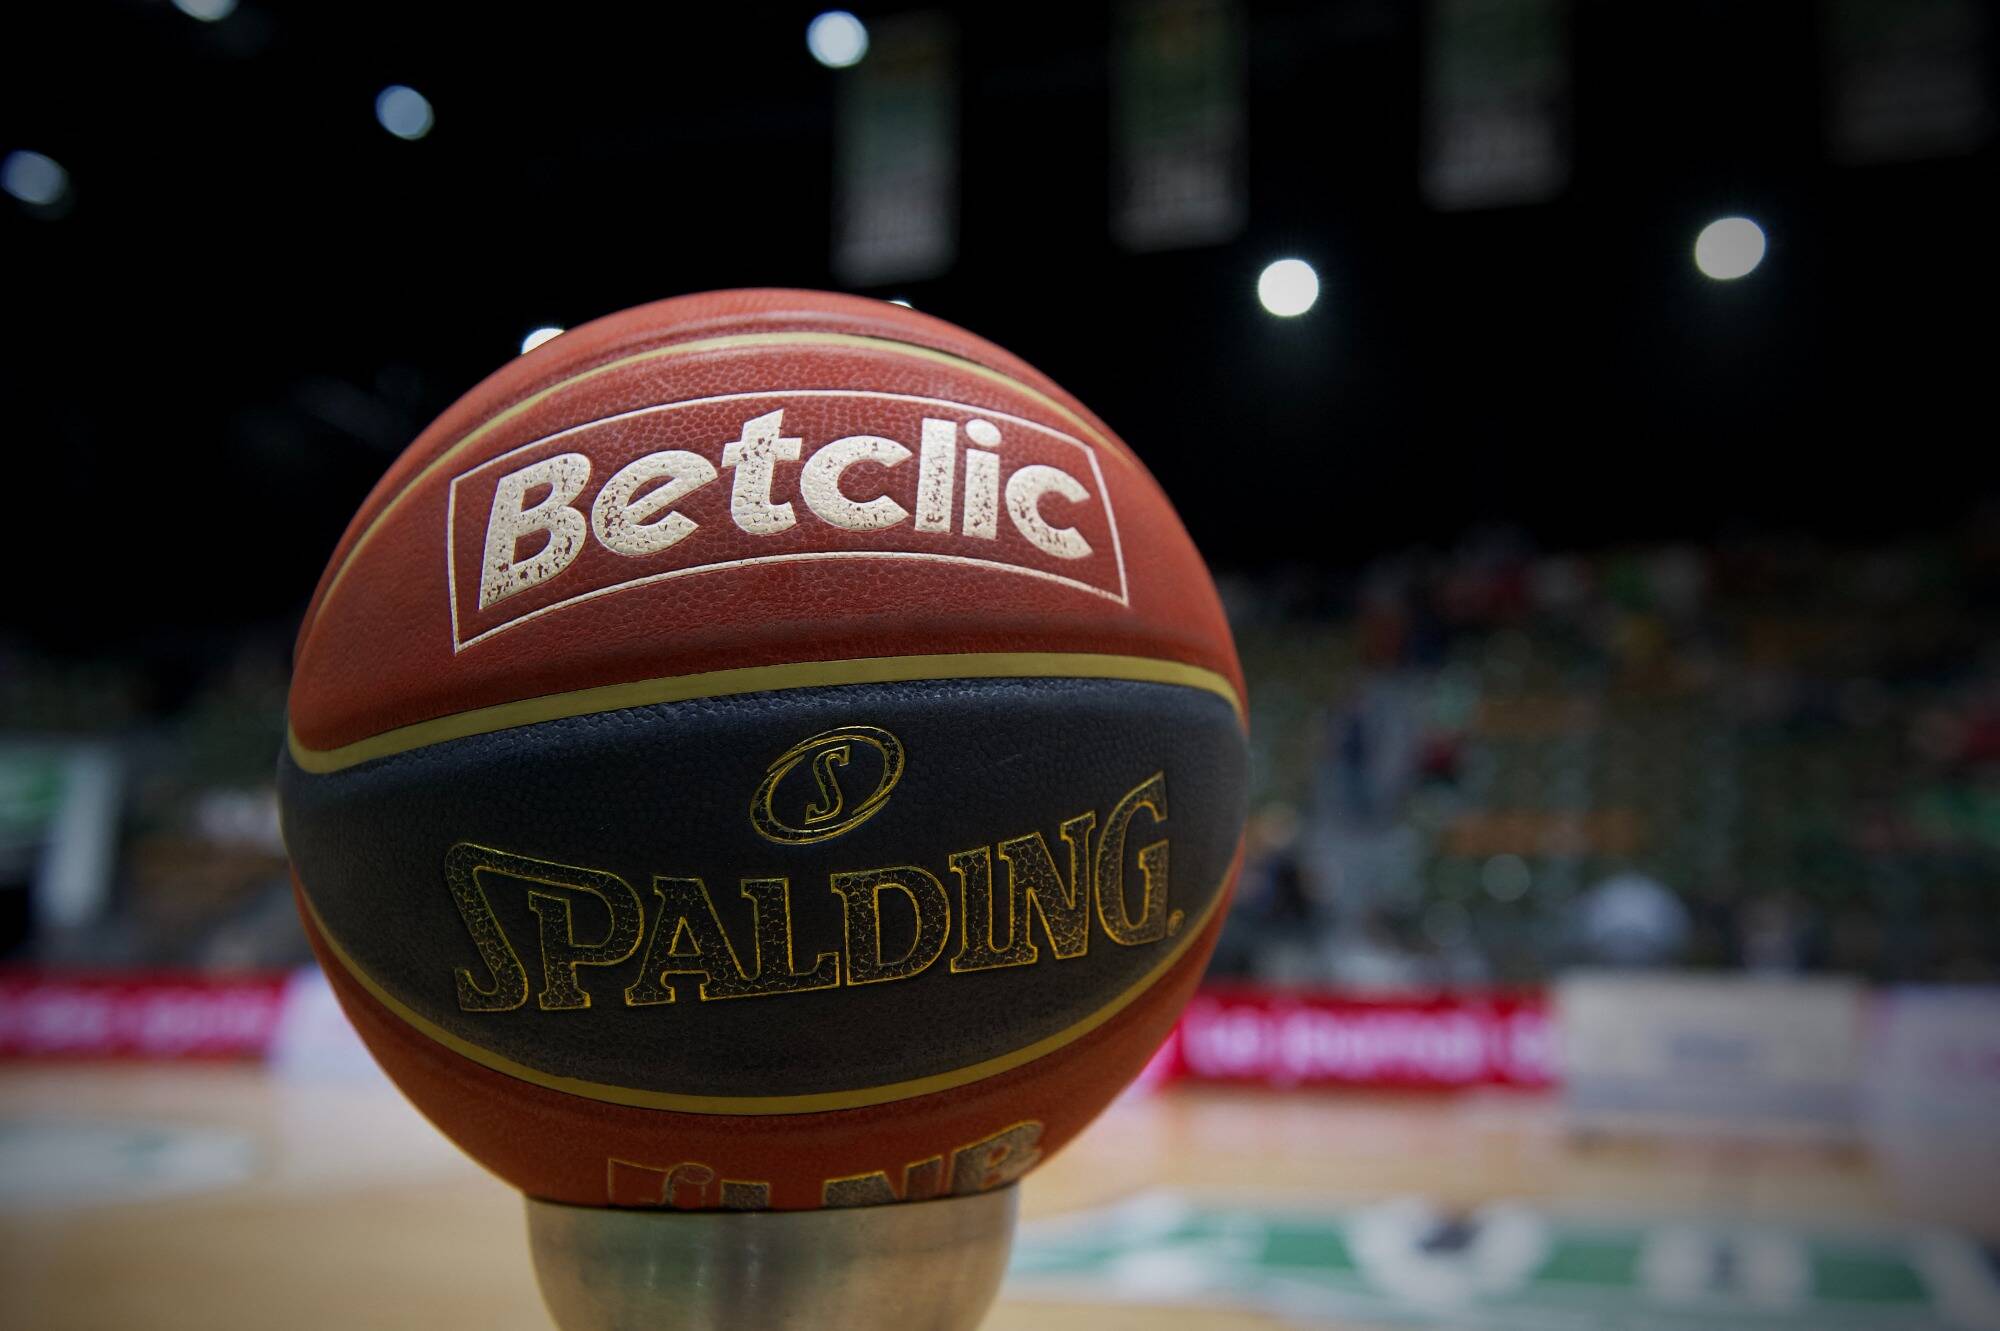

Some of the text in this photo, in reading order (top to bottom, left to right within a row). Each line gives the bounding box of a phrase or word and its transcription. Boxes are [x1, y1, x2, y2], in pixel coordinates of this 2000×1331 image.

[478, 408, 1094, 611] Betclic
[804, 743, 850, 826] S
[444, 770, 1169, 1012] SPALDING
